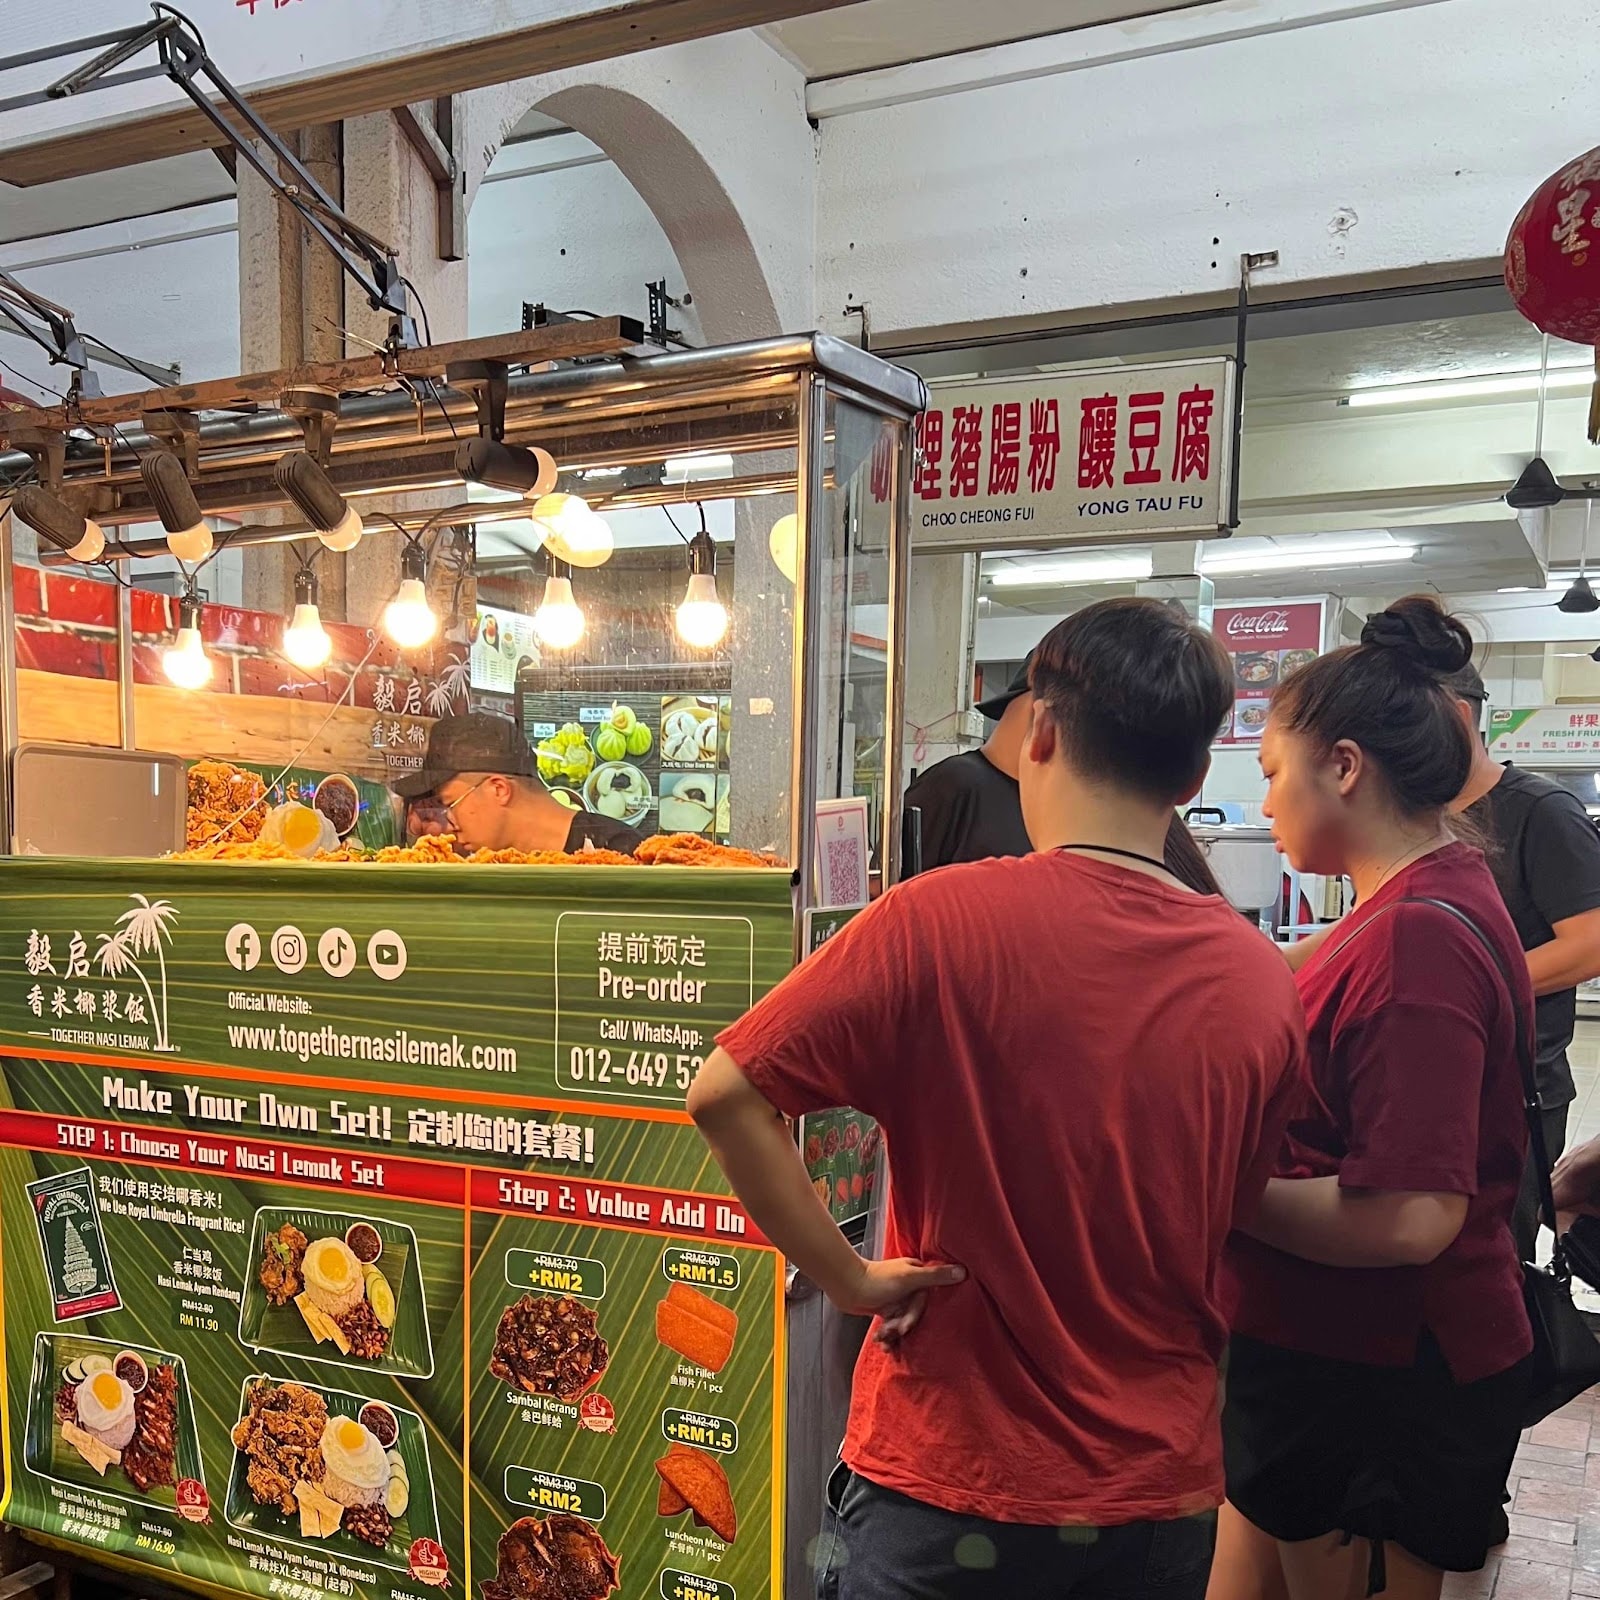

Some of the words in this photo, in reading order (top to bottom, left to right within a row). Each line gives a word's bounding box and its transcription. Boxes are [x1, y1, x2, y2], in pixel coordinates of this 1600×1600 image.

[1077, 383, 1214, 489] 釀豆腐
[922, 512, 956, 526] CHOO
[960, 508, 1011, 524] CHEONG
[1015, 507, 1034, 520] FUI
[1078, 500, 1129, 517] YONG
[1135, 497, 1172, 512] TAU
[1178, 496, 1203, 510] FU
[386, 754, 424, 768] TOGETHER
[597, 931, 707, 967] 提前预定
[598, 966, 707, 1004] Pre-order
[26, 984, 148, 1024] 香米椰浆饭
[228, 991, 265, 1012] Official
[266, 994, 312, 1015] Website:
[50, 1028, 95, 1046] TOGETHER
[96, 1032, 117, 1048] NASI
[119, 1034, 150, 1050] LEMAK
[632, 1020, 703, 1050] WhatsApp:
[228, 1024, 517, 1073] www.togethernasilemak.com
[570, 1046, 668, 1089] 012-649
[102, 1076, 172, 1115] Make
[183, 1084, 248, 1123] Your
[259, 1092, 318, 1132] Own
[330, 1100, 392, 1140] Set!
[407, 1108, 594, 1164] 定制您的套餐!
[57, 1122, 96, 1148] STEP
[102, 1130, 115, 1151] 1:
[120, 1131, 180, 1160] Choose
[187, 1139, 228, 1166] Your
[235, 1145, 275, 1173] Nasi
[282, 1151, 343, 1182] Lemak
[351, 1160, 384, 1187] Set
[100, 1197, 112, 1212] We
[113, 1199, 127, 1215] Use
[128, 1202, 150, 1221] Royal
[150, 1205, 186, 1225] Umbrella
[187, 1212, 222, 1232] Fragrant
[223, 1216, 244, 1234] Rice!
[498, 1178, 549, 1212] Step
[558, 1184, 576, 1212] 2:
[586, 1188, 650, 1222] Value
[660, 1198, 706, 1228] Add
[716, 1204, 745, 1234] On
[182, 1246, 212, 1264] 仁当鸡
[529, 1269, 583, 1292] +RM2
[668, 1262, 734, 1286] +RM1.5
[158, 1274, 172, 1288] Nasi
[172, 1277, 193, 1292] Lemak
[194, 1281, 212, 1296] Ayam
[212, 1284, 240, 1303] Rendang
[180, 1313, 194, 1327] RM
[195, 1316, 218, 1332] 11.90
[678, 1364, 694, 1376] Fish
[695, 1367, 716, 1380] Fillet
[709, 1384, 723, 1394] pcs
[506, 1392, 542, 1410] Sambal
[543, 1398, 578, 1418] Kerang
[667, 1424, 732, 1448] +RM1.5
[528, 1488, 582, 1512] +RM2
[136, 1534, 150, 1548] RM
[152, 1540, 176, 1555] 16.90
[664, 1528, 704, 1546] Luncheon
[705, 1538, 726, 1552] Meat
[228, 1534, 242, 1548] Nasi
[242, 1538, 264, 1555] Lemak
[266, 1544, 283, 1560] Paha
[284, 1550, 302, 1565] Ayam
[303, 1554, 328, 1574] Goreng
[328, 1562, 339, 1574] XL
[340, 1565, 376, 1585] (Boneless)
[707, 1552, 721, 1562] pcs
